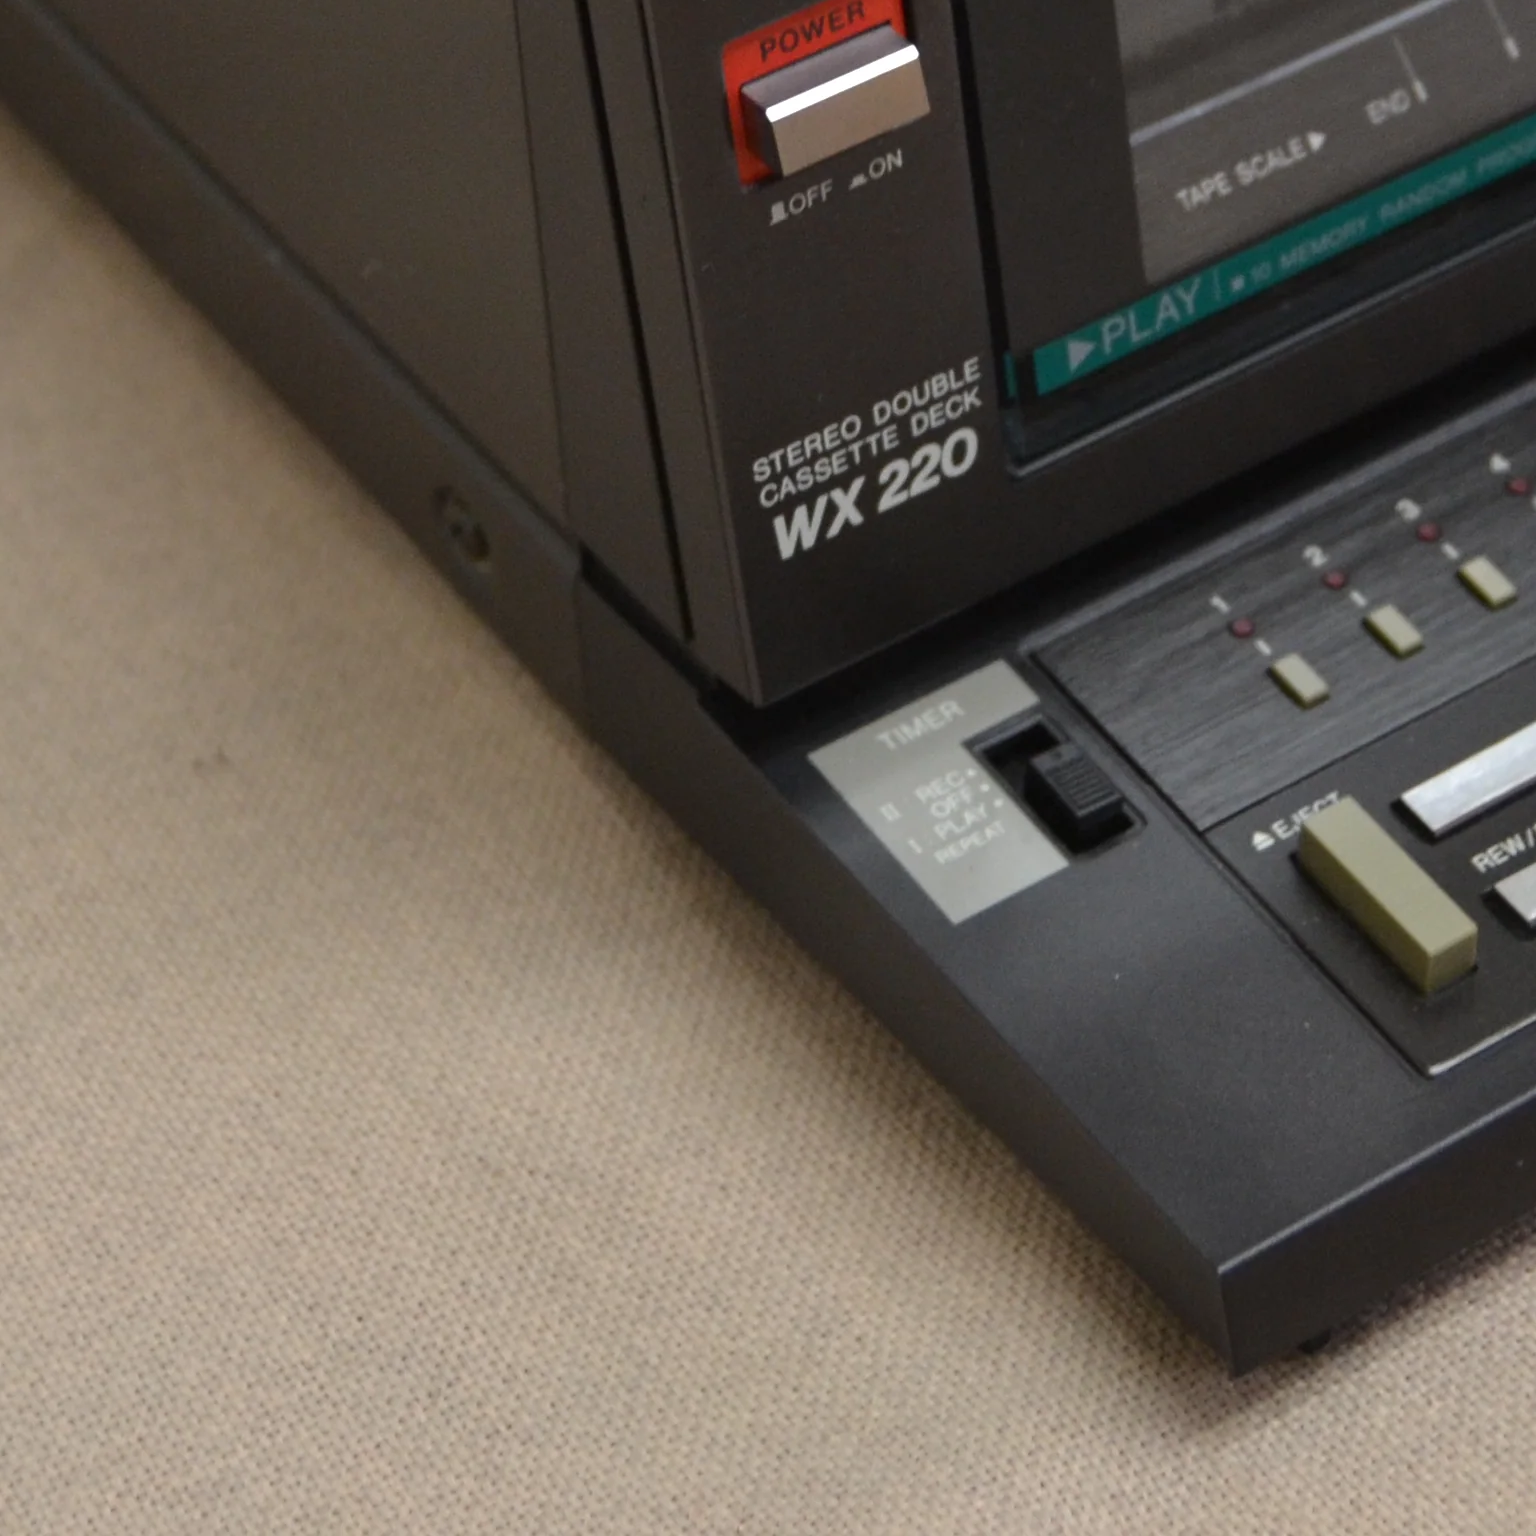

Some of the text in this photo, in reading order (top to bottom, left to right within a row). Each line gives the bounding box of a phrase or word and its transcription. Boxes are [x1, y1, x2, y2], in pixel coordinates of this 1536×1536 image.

[758, 0, 865, 62] POWER
[1365, 88, 1411, 125] END
[787, 148, 904, 217] OFF ON
[1174, 136, 1307, 212] TAPE SCALE
[1100, 275, 1203, 355] PLAY
[1280, 216, 1370, 270] MEMORY
[1379, 168, 1468, 222] RANDOM
[752, 356, 982, 483] STEREO DOUBLE
[759, 386, 982, 508] CASSETTE DECK
[773, 426, 979, 561] WX 220
[1395, 496, 1423, 523] 3
[1302, 543, 1329, 568] 2
[1209, 594, 1231, 614] 1
[876, 700, 965, 751] TIMER
[915, 770, 965, 805] REC
[930, 786, 972, 818] OFF
[933, 802, 988, 841] PLAY
[933, 820, 1006, 865] REPEAT
